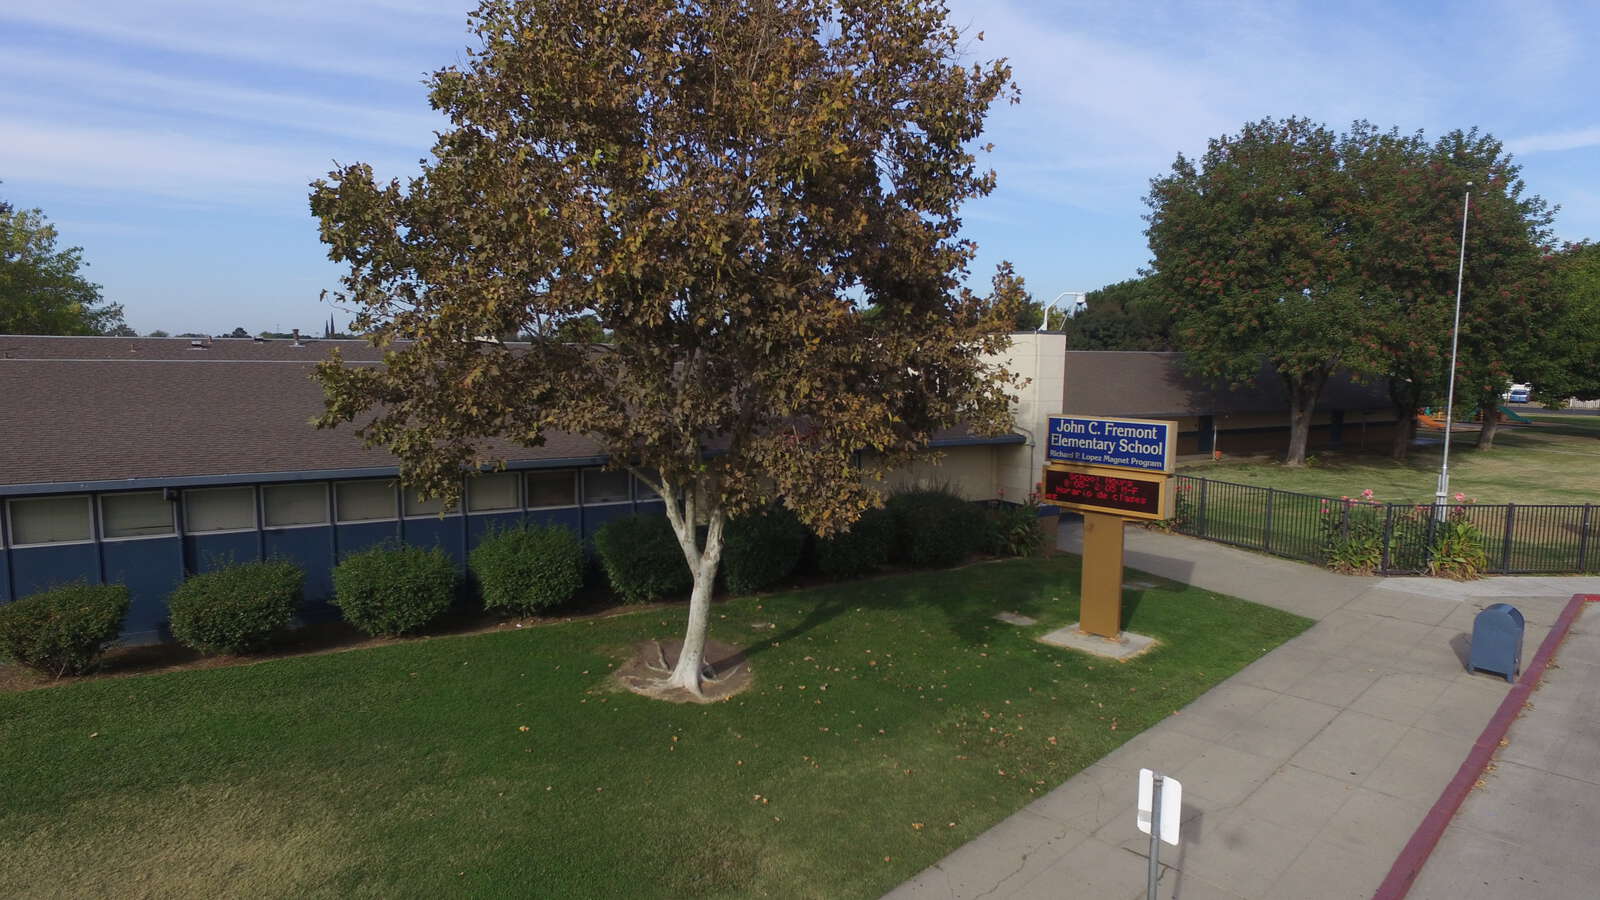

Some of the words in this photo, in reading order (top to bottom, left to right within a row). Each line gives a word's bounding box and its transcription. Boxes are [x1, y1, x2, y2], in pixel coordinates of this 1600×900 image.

[1057, 419, 1085, 434] John
[1088, 421, 1100, 435] C.
[1104, 422, 1158, 439] Fremont
[1051, 433, 1116, 454] Elementary
[1119, 439, 1163, 455] School
[1082, 452, 1102, 462] Lopez
[1103, 455, 1130, 465] Magnet
[1131, 457, 1162, 468] Program
